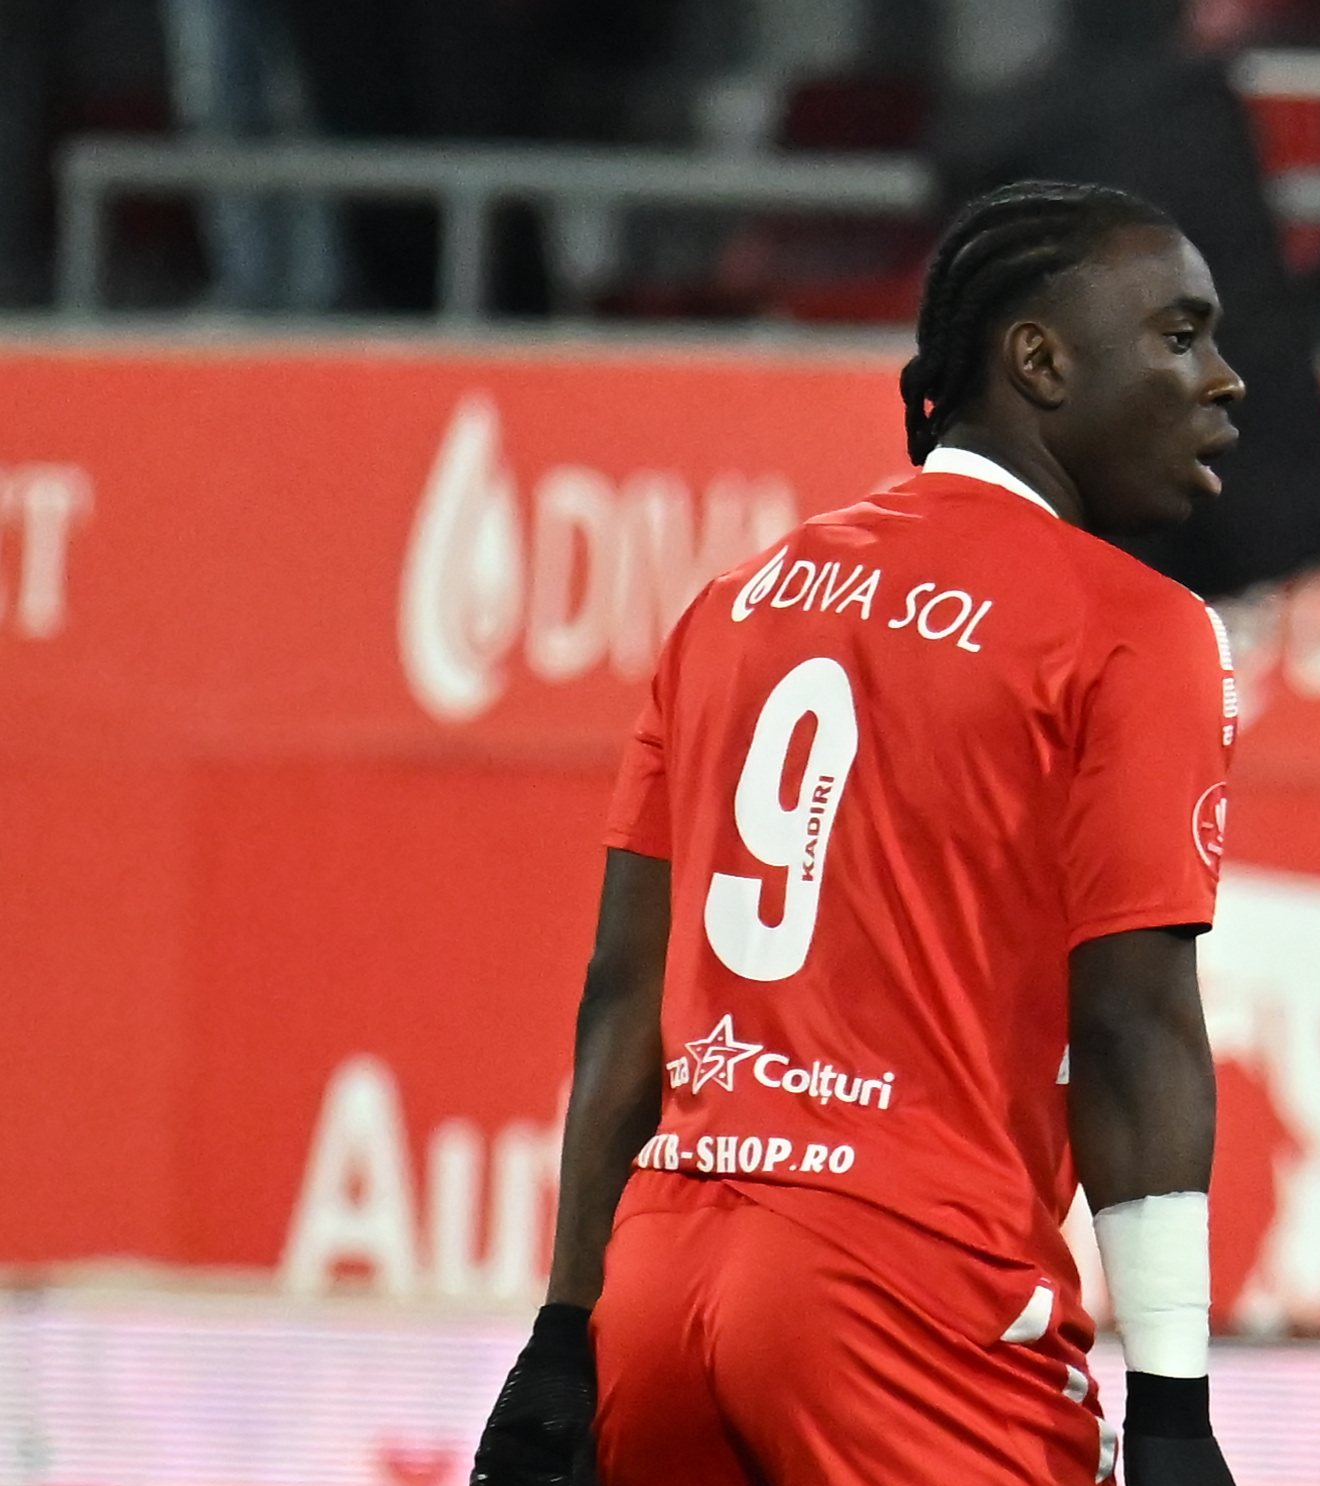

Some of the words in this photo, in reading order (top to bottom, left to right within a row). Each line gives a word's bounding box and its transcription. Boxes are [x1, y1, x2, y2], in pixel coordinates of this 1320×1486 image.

[771, 560, 881, 620] DIVA
[888, 583, 992, 652] SOL
[703, 657, 859, 982] 9
[802, 774, 835, 882] KADIRI
[753, 1053, 896, 1110] Colțuri
